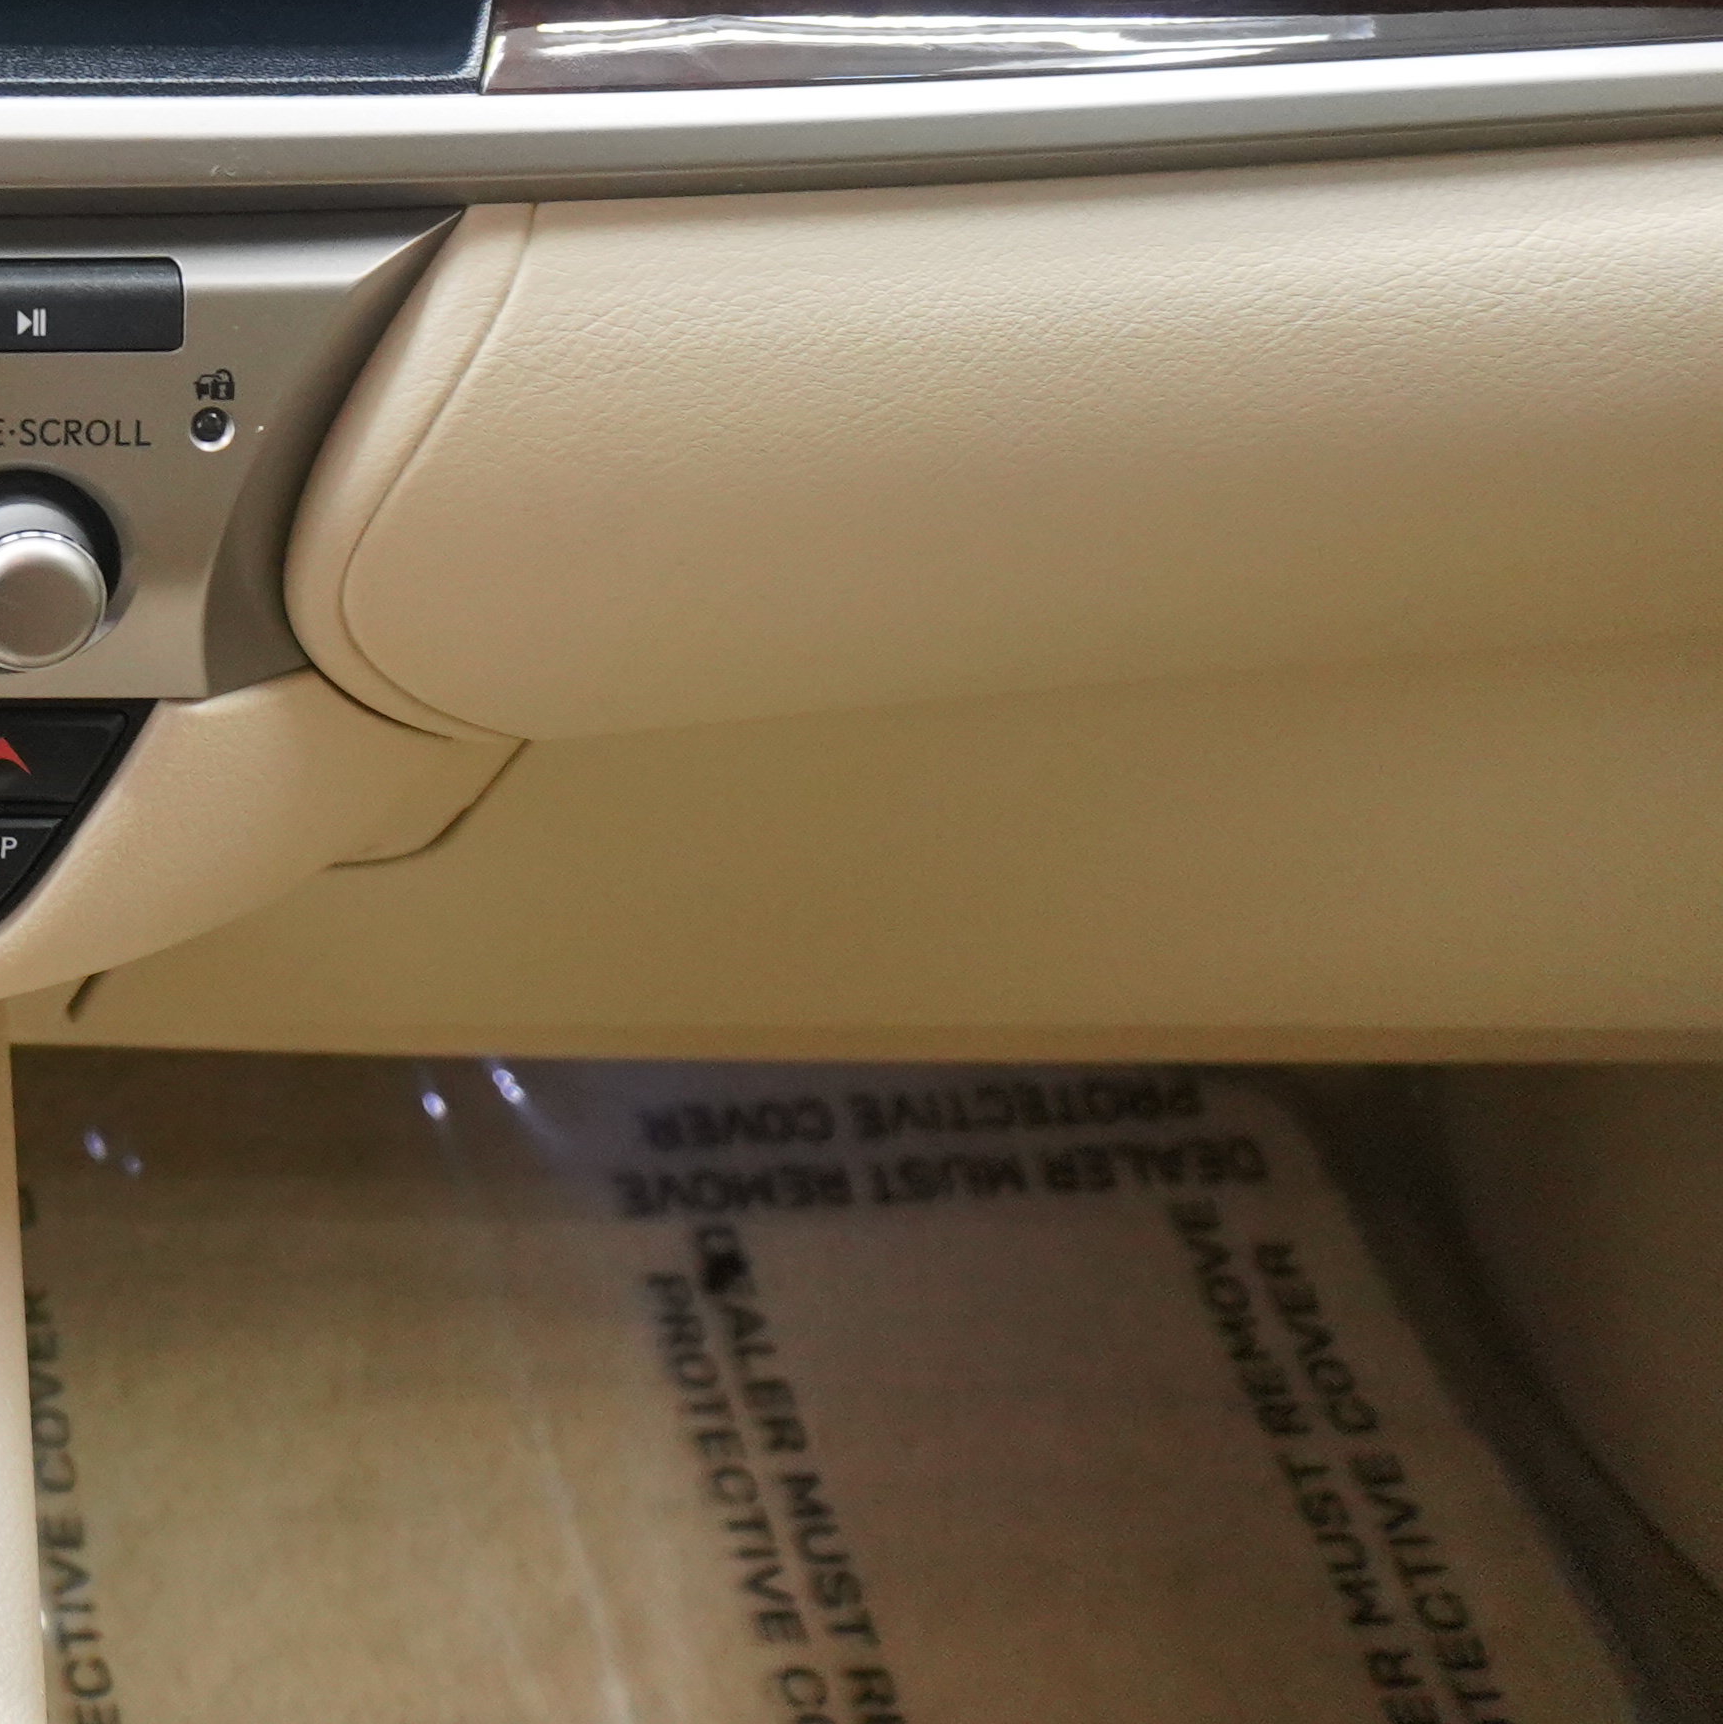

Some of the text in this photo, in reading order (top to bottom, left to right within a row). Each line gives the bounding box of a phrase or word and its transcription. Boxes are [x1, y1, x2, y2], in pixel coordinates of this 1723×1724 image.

[615, 1135, 1267, 1220] DEALER MUST REMOVE
[641, 1076, 1202, 1153] PROTECTIVE COVER
[1168, 1196, 1313, 1442] REMOVE
[1252, 1239, 1379, 1438] COVER
[645, 1269, 813, 1649] PROTECTIVE
[1279, 1449, 1395, 1633] MUST
[779, 1469, 881, 1651] MUST
